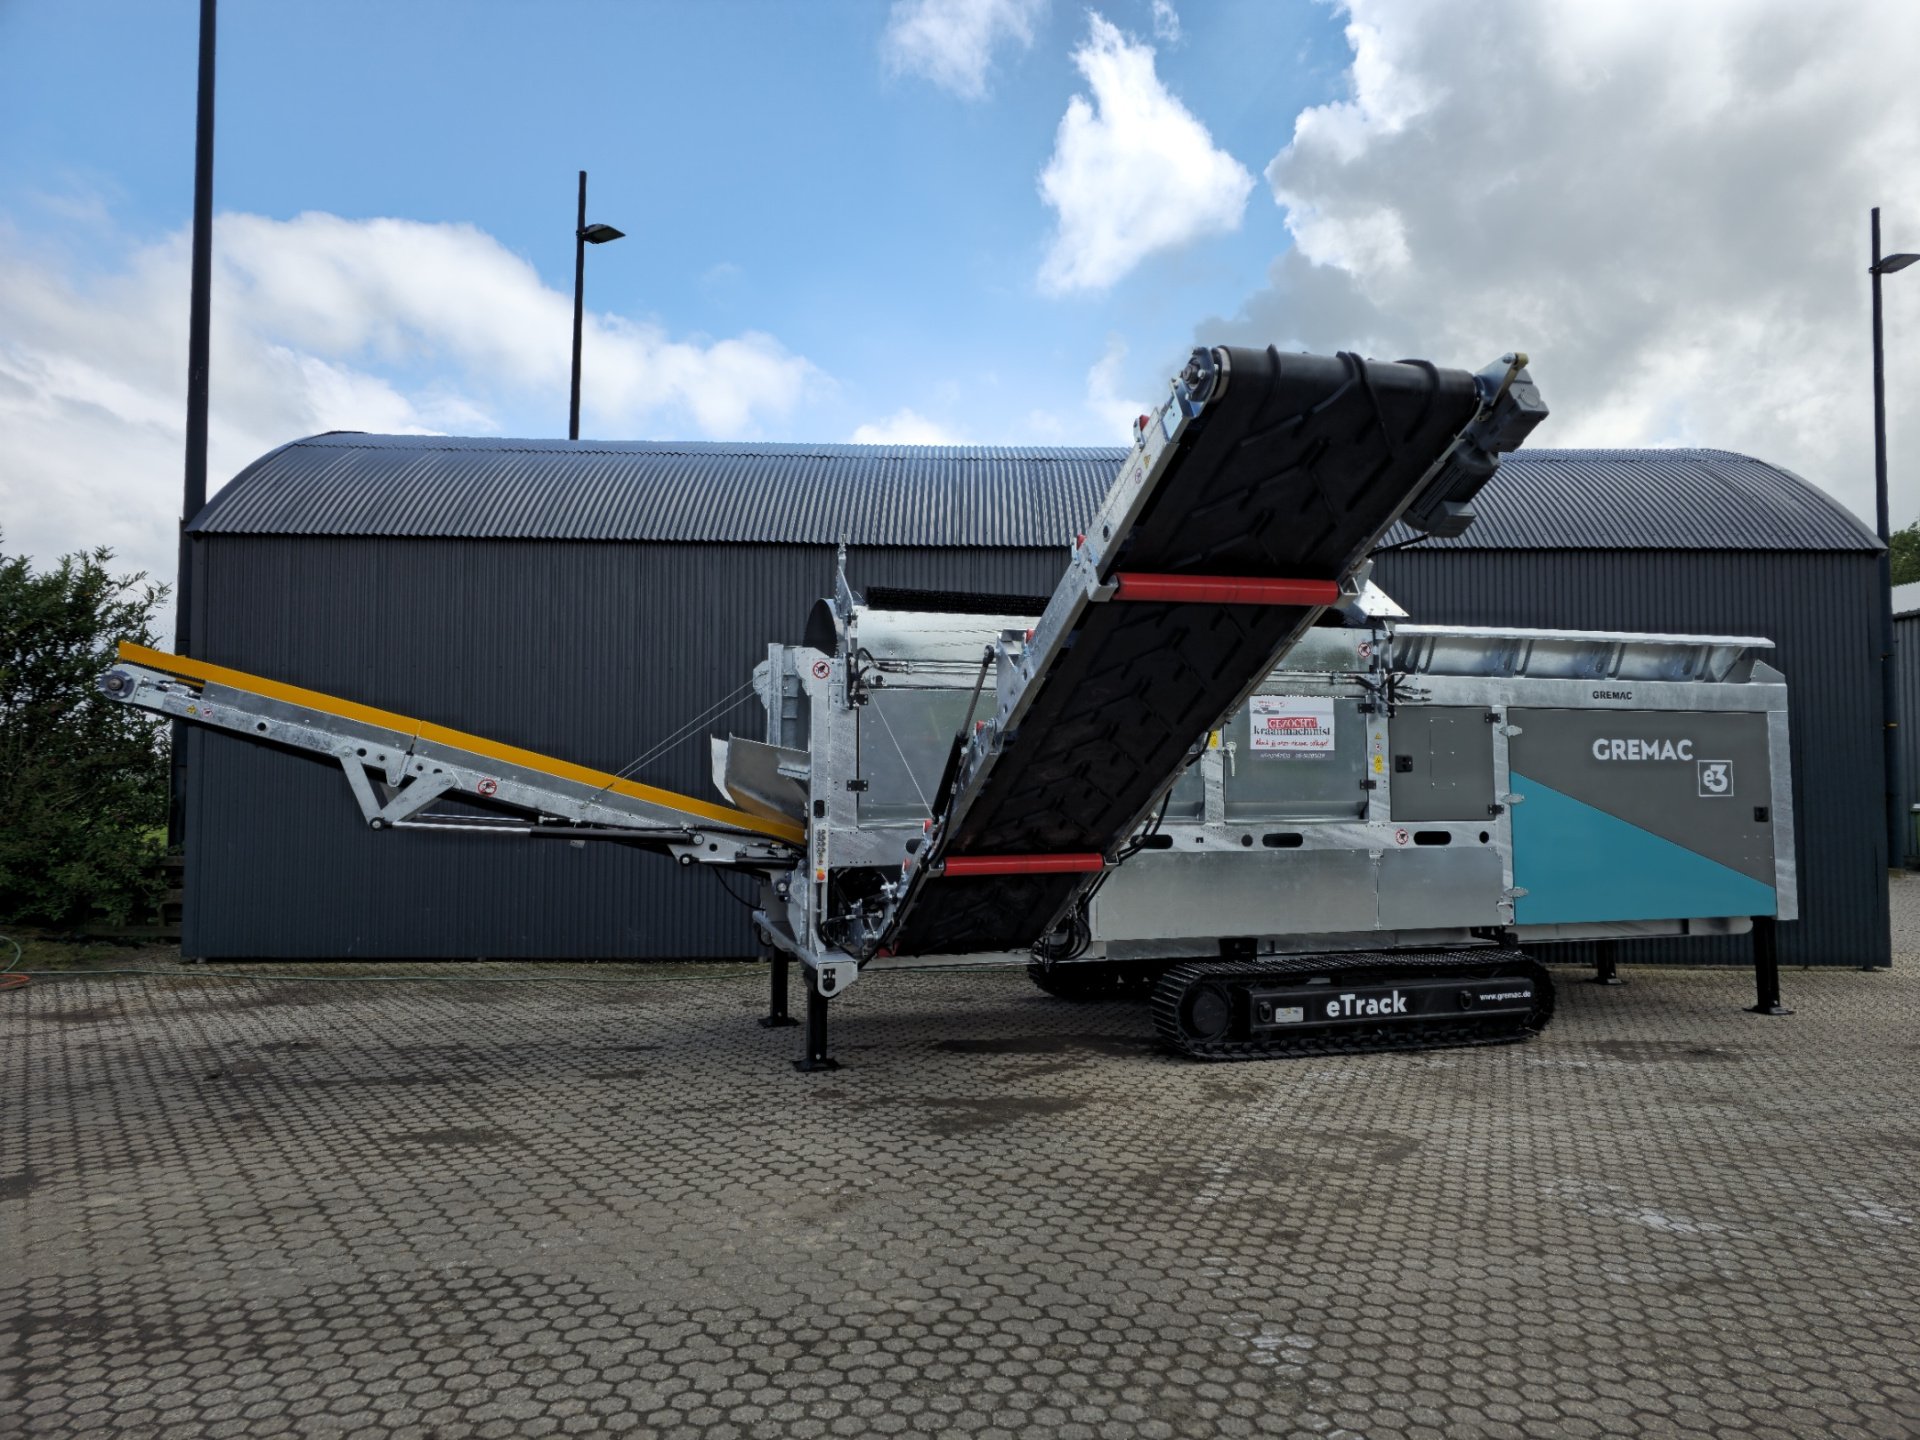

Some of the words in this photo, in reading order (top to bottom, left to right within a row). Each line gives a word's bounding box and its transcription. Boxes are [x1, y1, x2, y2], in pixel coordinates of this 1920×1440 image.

[1592, 690, 1633, 700] GREMAC
[1254, 725, 1330, 735] kraanmachinist
[1592, 738, 1693, 761] GREMAC
[1703, 764, 1728, 792] e3
[1326, 990, 1407, 1017] eTrack
[1479, 990, 1532, 1002] www.gremac.de
